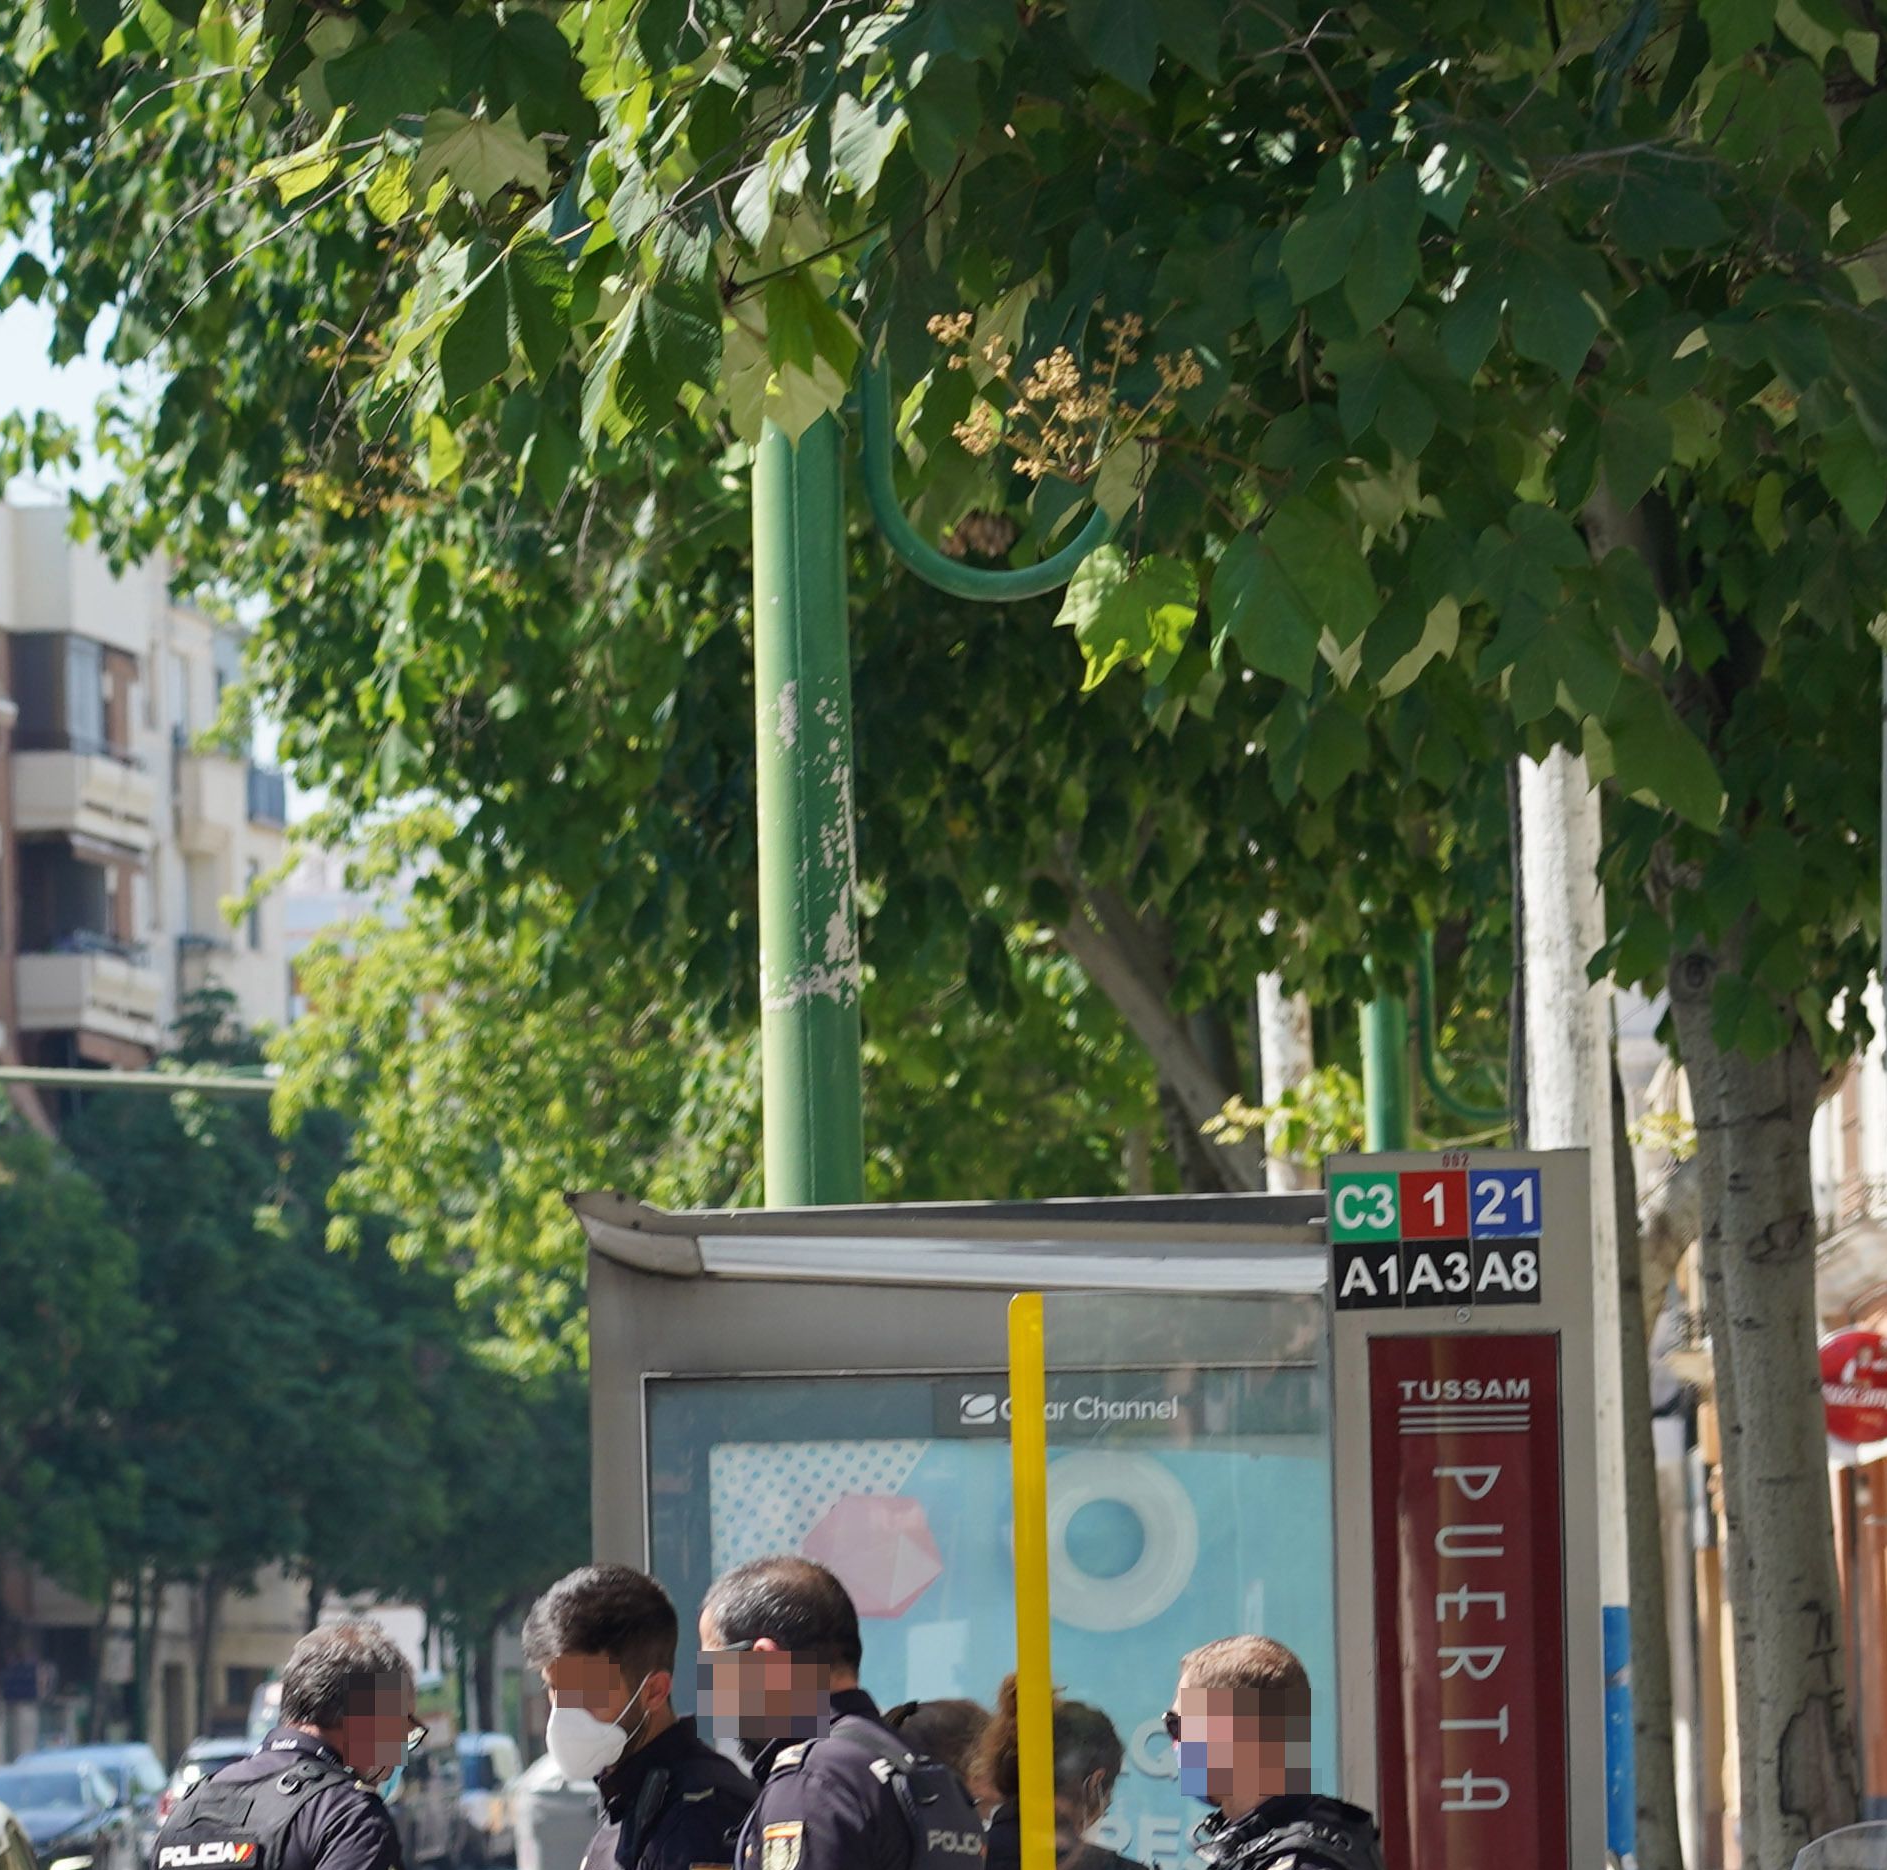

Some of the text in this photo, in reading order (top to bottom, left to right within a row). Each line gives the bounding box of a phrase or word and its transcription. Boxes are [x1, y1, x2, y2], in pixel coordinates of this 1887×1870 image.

[1334, 1177, 1534, 1230] C3 1 21
[1339, 1249, 1539, 1298] A1 A3 A8
[1072, 1395, 1179, 1422] Channel
[1397, 1378, 1531, 1401] TUSSAM
[1432, 1464, 1511, 1812] PUERTA
[927, 1829, 982, 1856] POLICI
